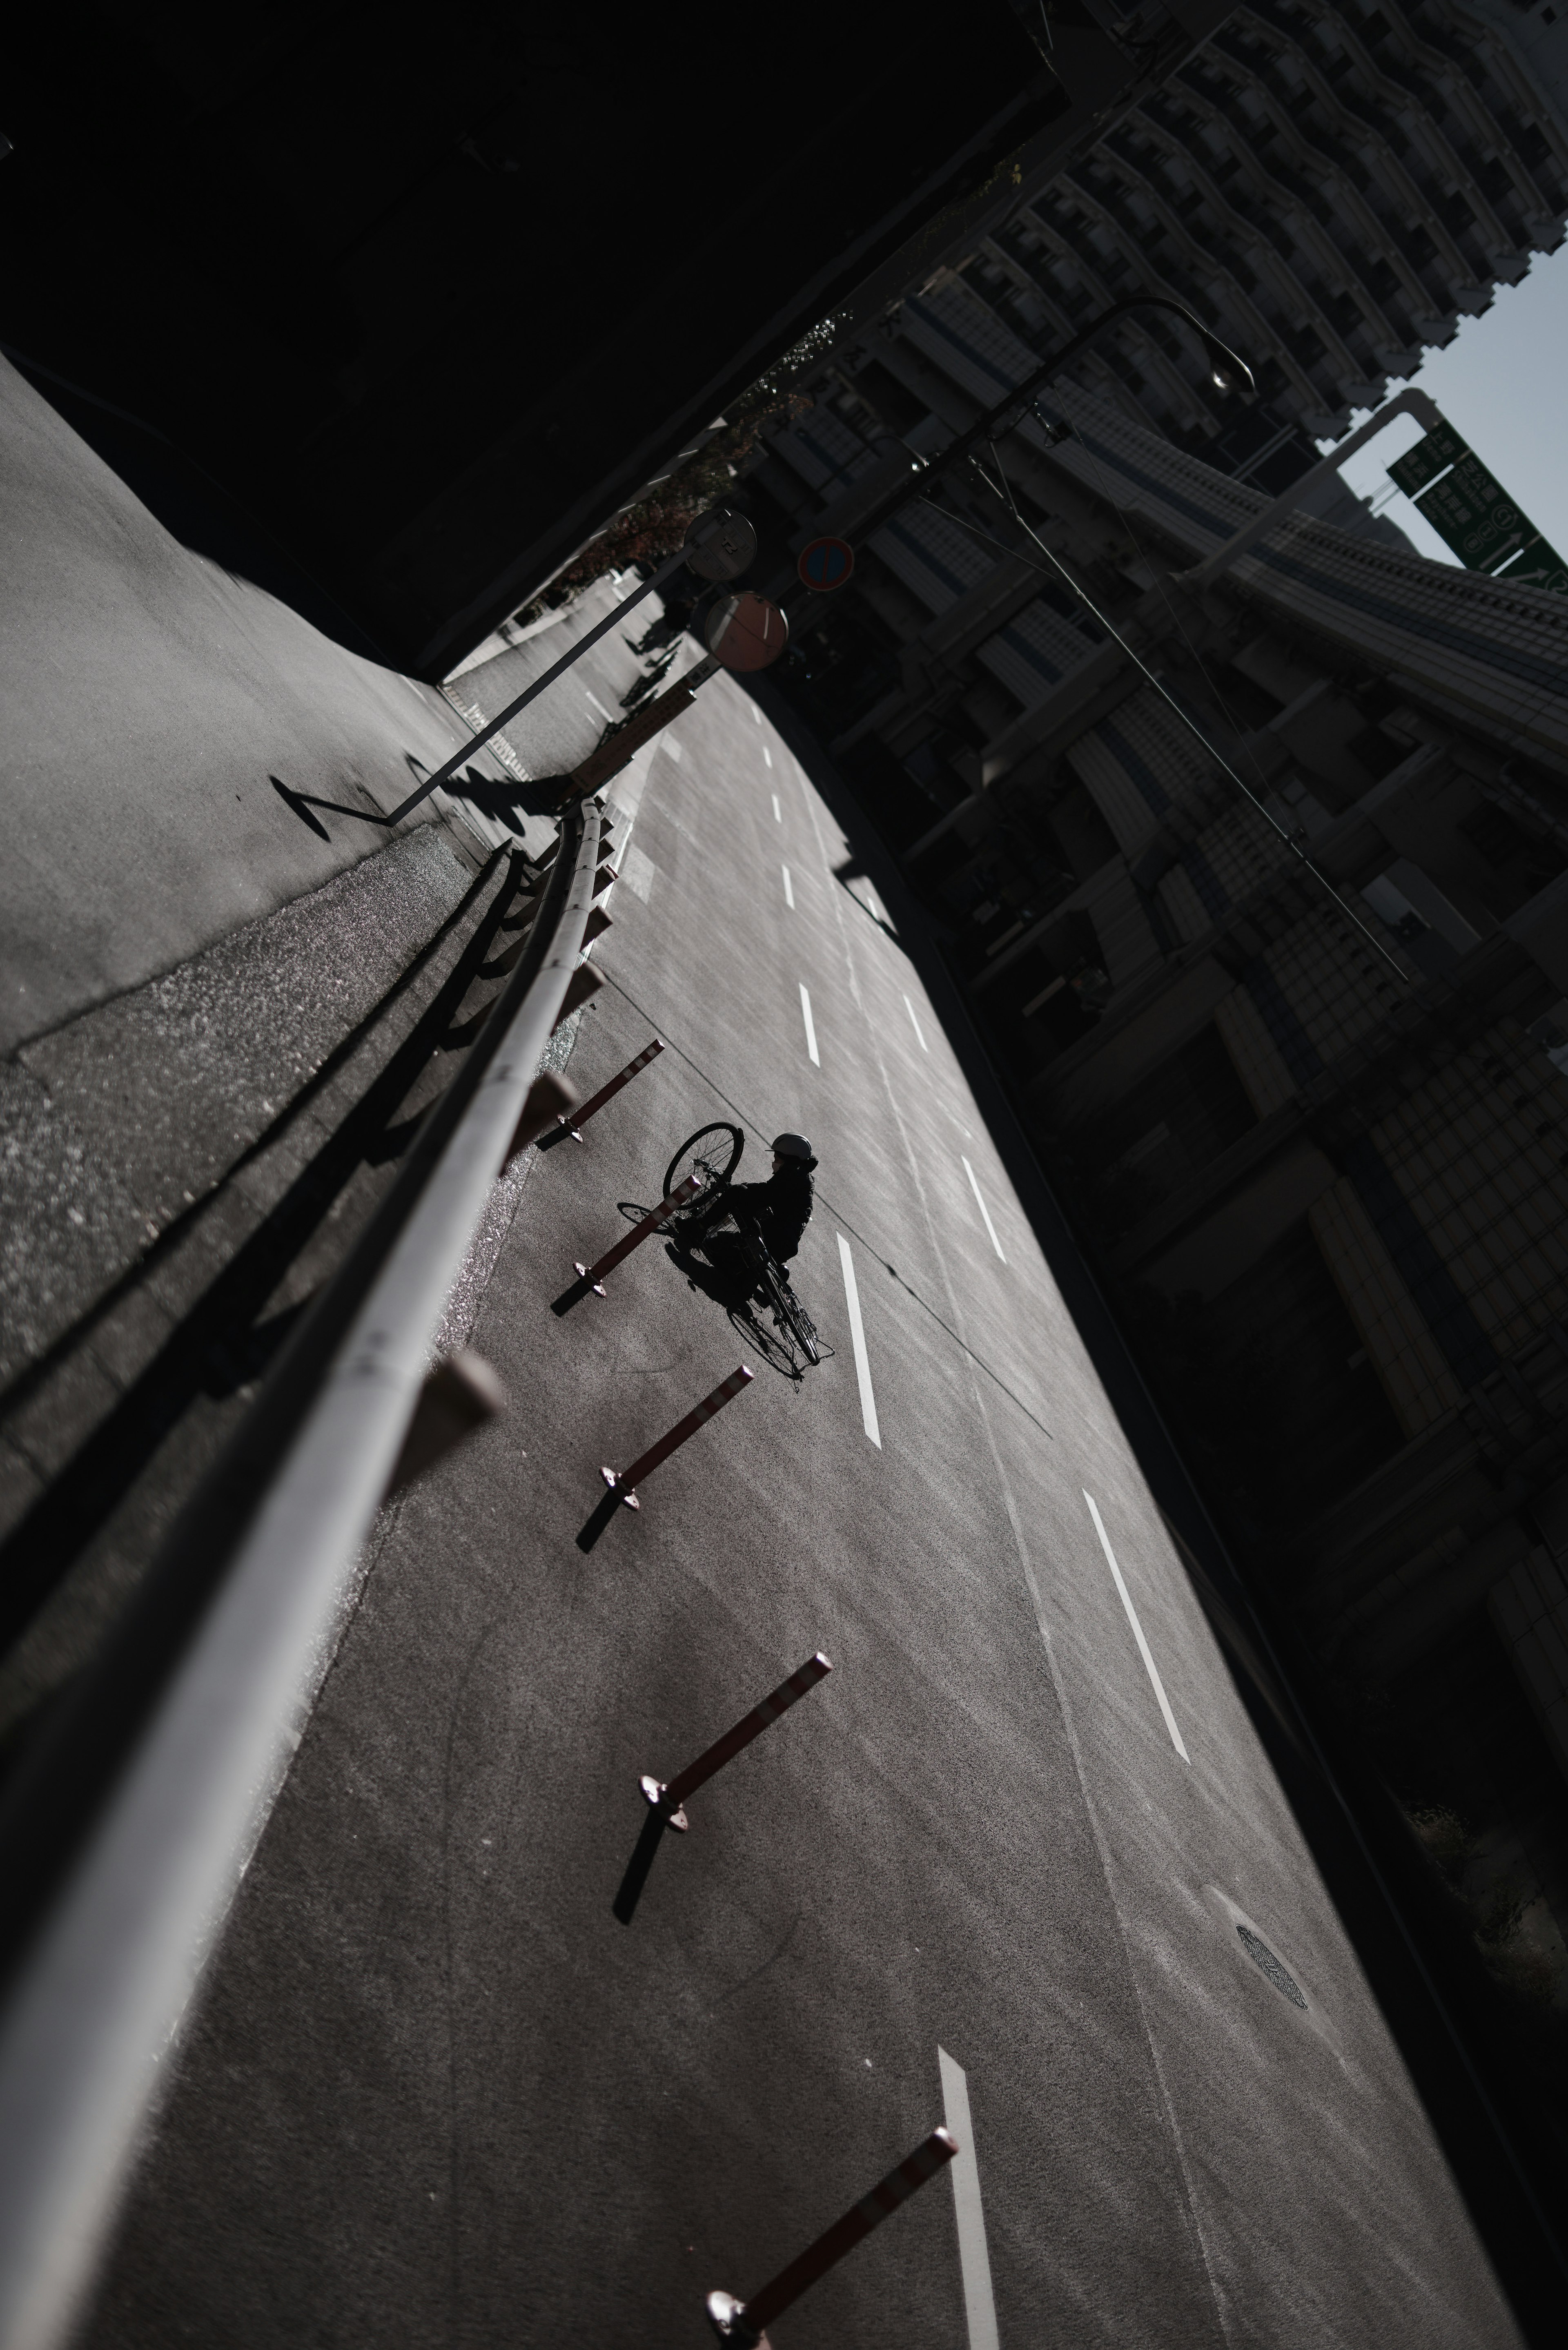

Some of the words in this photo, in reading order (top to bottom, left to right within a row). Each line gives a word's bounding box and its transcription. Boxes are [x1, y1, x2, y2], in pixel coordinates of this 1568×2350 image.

[1422, 437, 1442, 462] Ueno
[1430, 430, 1455, 455] 上野
[1396, 459, 1421, 491] Yokohama
[1404, 450, 1429, 479] 横浜
[1460, 458, 1499, 502] 芝公園
[1434, 481, 1472, 525] 湾岸線
[1497, 509, 1512, 526] C1
[1482, 526, 1491, 537] 1
[1551, 579, 1568, 594] 2
[690, 662, 710, 684] 注意
